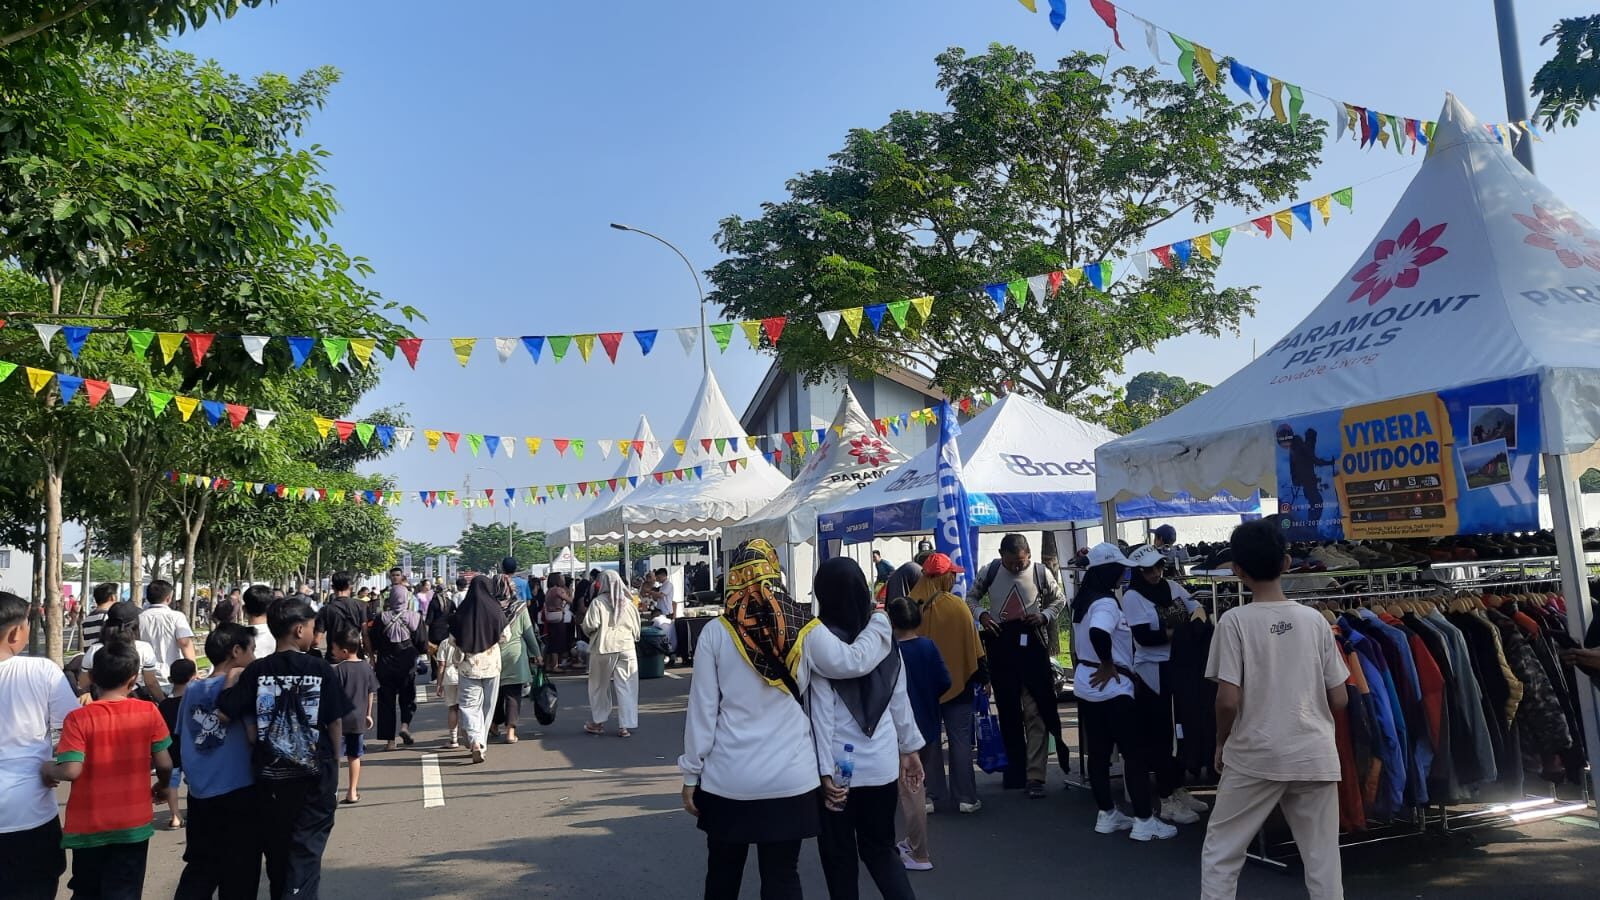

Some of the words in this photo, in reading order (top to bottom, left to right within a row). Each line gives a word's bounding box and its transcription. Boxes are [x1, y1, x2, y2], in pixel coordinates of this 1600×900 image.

[1267, 294, 1480, 356] PARAMOUNT
[1283, 327, 1402, 369] PETALS
[1343, 410, 1433, 448] VYRERA
[1342, 440, 1439, 475] OUTDOOR
